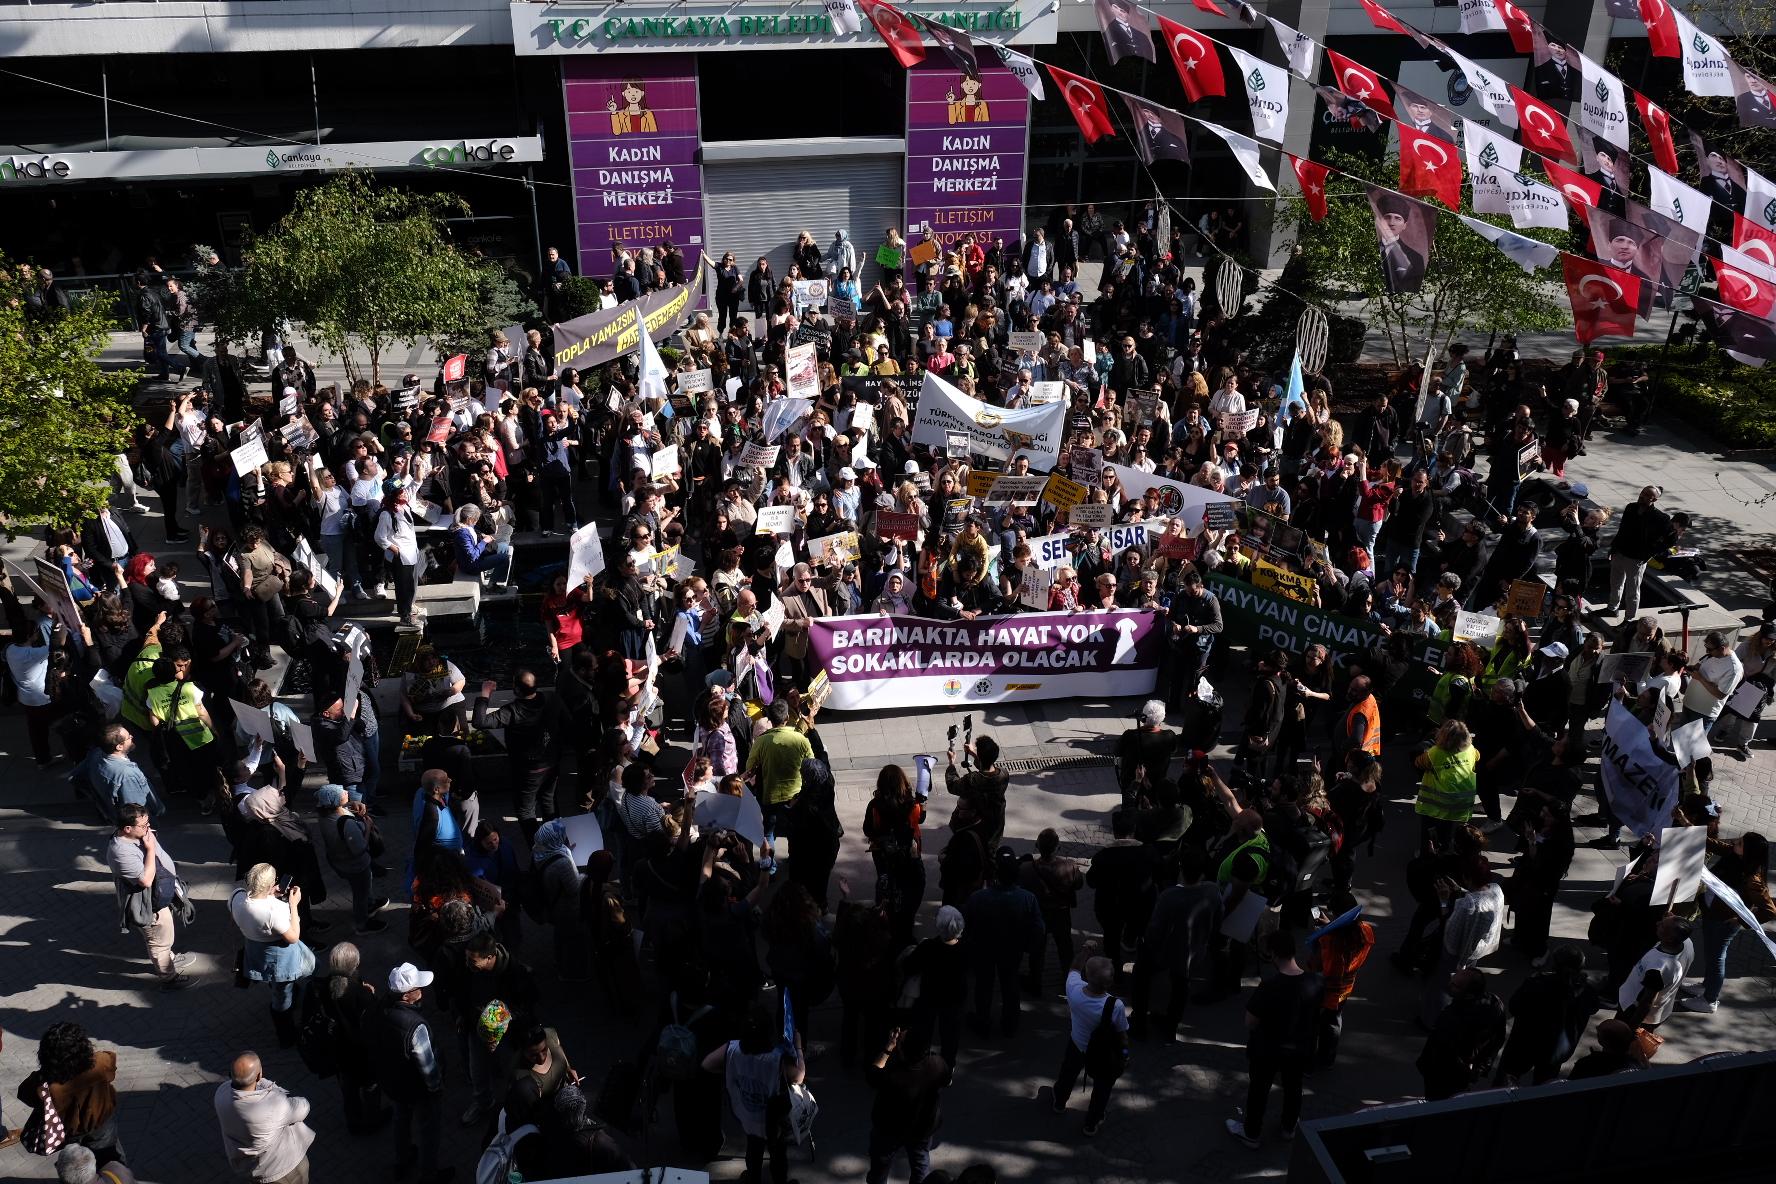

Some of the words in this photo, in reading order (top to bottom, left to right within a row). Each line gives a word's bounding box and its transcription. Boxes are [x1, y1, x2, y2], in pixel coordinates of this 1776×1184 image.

[604, 16, 731, 42] ÇANKAYA
[942, 135, 991, 151] KADIN
[281, 152, 321, 163] Çankaya
[608, 145, 661, 162] KADIN
[932, 156, 1000, 174] DANIŞMA
[599, 167, 674, 188] DANIŞMA
[933, 172, 998, 192] MERKEZİ
[603, 184, 673, 207] MERKEZİ
[934, 207, 994, 226] İLETİŞİM
[608, 222, 673, 242] İLETİŞİM
[919, 417, 956, 430] HAYVAN
[930, 408, 964, 427] TÜRKİYE
[967, 426, 1004, 440] BAROLA
[1259, 568, 1303, 586] KORKMA
[1209, 580, 1297, 626] HAYVAN
[833, 627, 970, 648] BARINAKTA
[978, 626, 1051, 646] HAYAT
[1056, 624, 1104, 643] YOK
[831, 651, 995, 675] SOKAKLARDA
[1002, 650, 1098, 668] OLACAK
